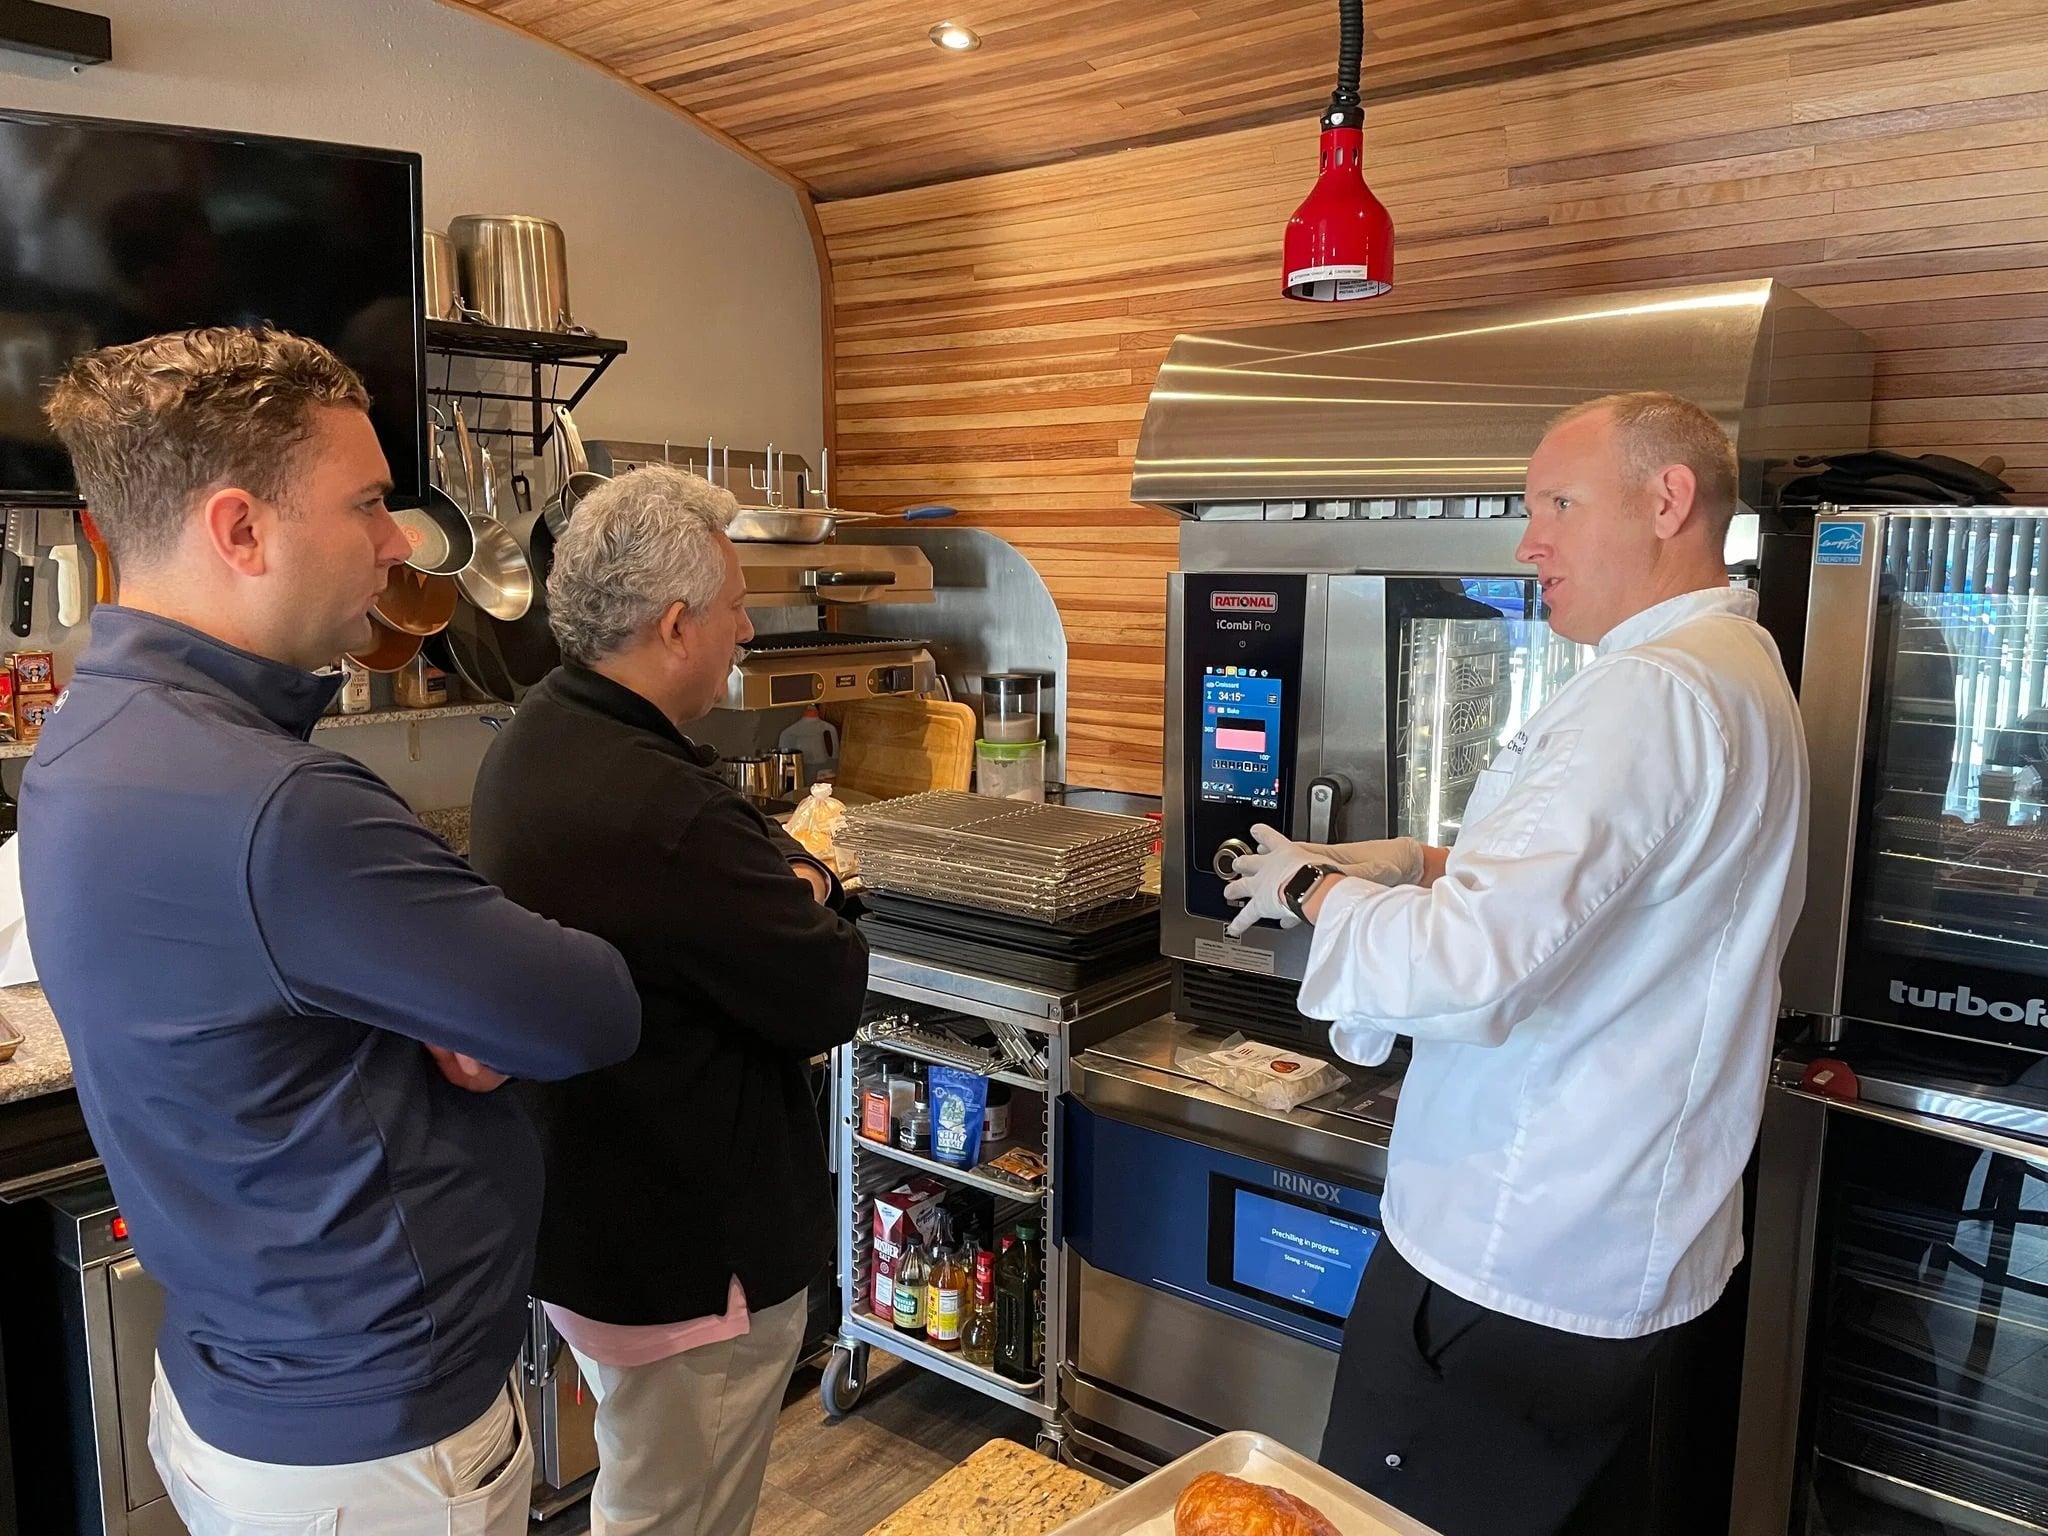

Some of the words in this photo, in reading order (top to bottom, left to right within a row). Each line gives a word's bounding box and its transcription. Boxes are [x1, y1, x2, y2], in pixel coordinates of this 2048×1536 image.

[1215, 596, 1273, 608] RATIONAL
[1216, 619, 1252, 631] iCombi
[1254, 620, 1271, 632] Pro
[1889, 979, 2048, 1028] turbof
[1273, 1169, 1340, 1204] IRINOX
[1271, 1228, 1304, 1246] Prechilling
[1304, 1238, 1311, 1247] in
[1311, 1241, 1340, 1256] progress
